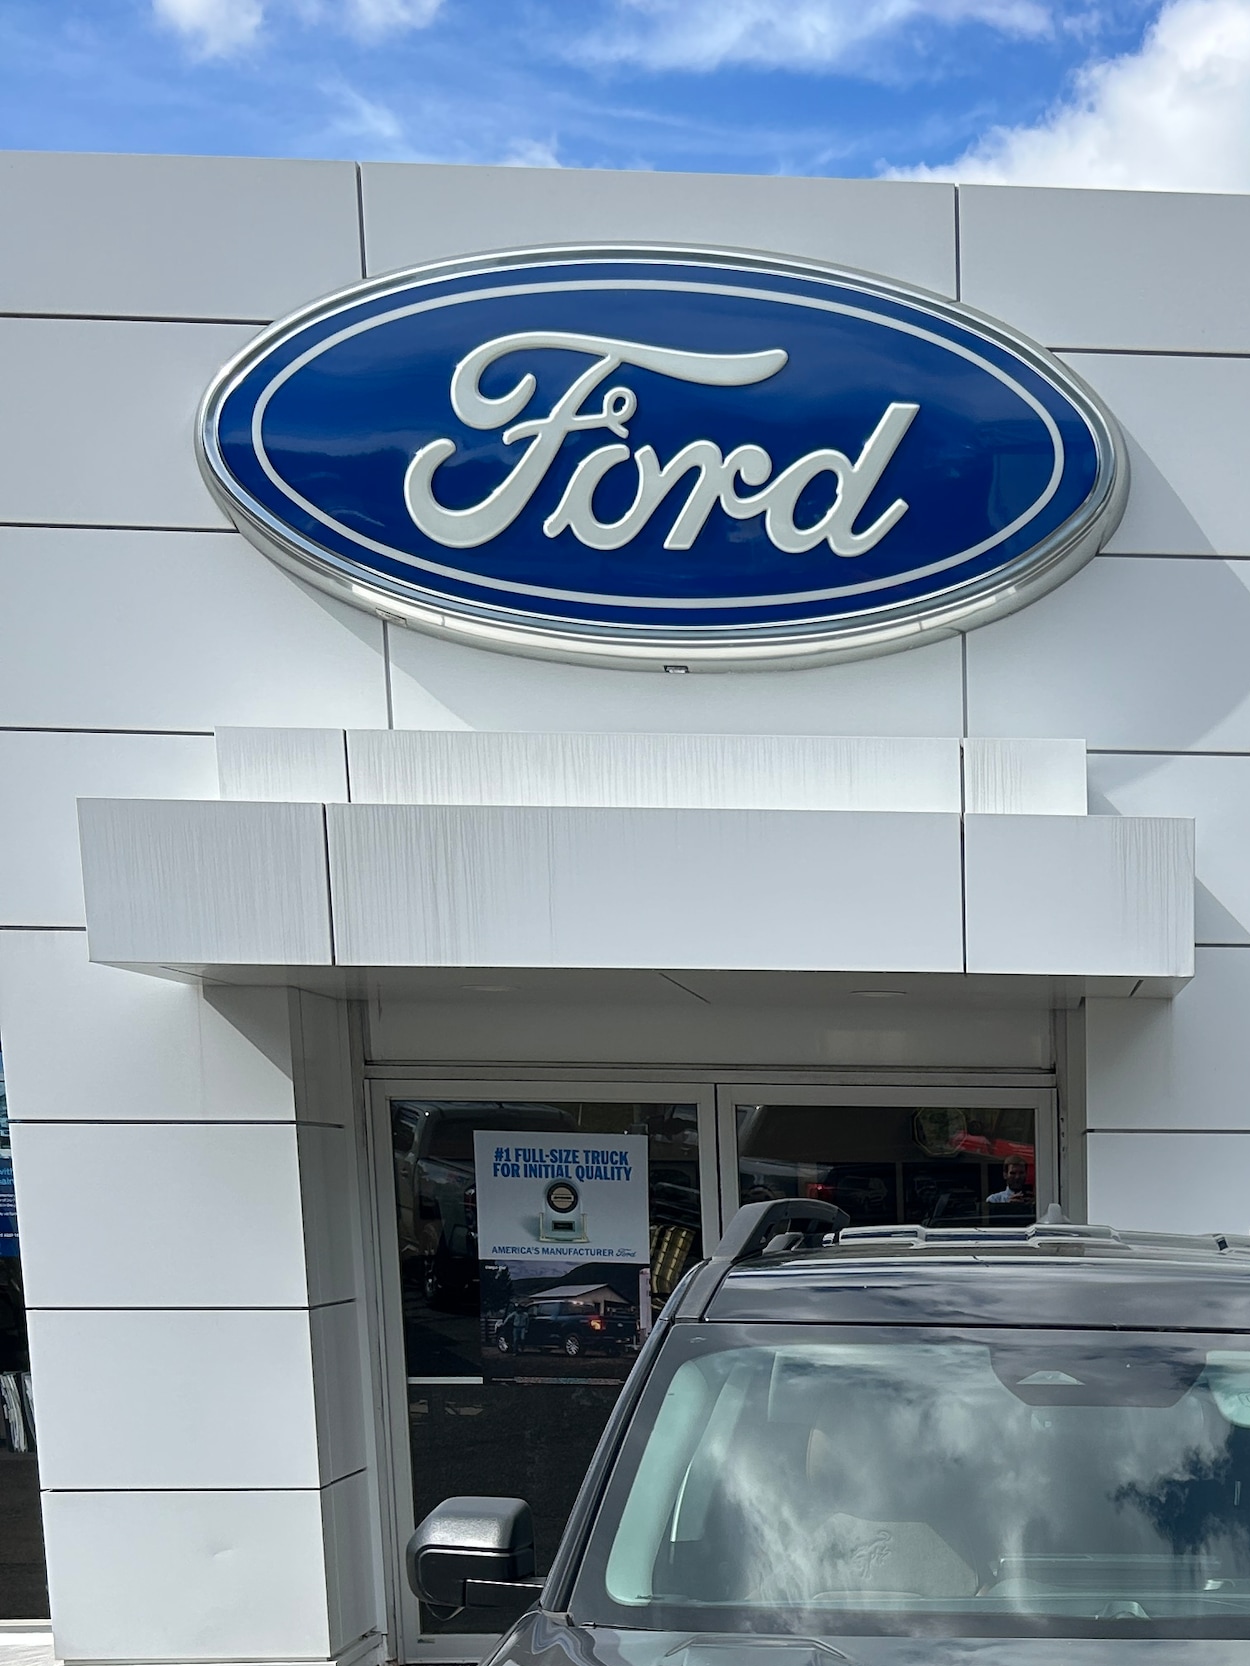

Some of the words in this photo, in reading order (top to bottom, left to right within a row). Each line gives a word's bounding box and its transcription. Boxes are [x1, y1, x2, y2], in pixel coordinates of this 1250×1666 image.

[404, 330, 919, 557] Ford
[494, 1147, 511, 1162] #1
[515, 1148, 580, 1164] FULL-SIZE
[583, 1150, 629, 1166] TRUCK
[493, 1163, 521, 1178] FOR
[523, 1164, 572, 1180] INITIAL
[575, 1165, 632, 1182] QUALITY
[491, 1246, 540, 1255] AMERICA'S
[541, 1247, 614, 1257] MANUFACTURER
[615, 1248, 637, 1258] Ford
